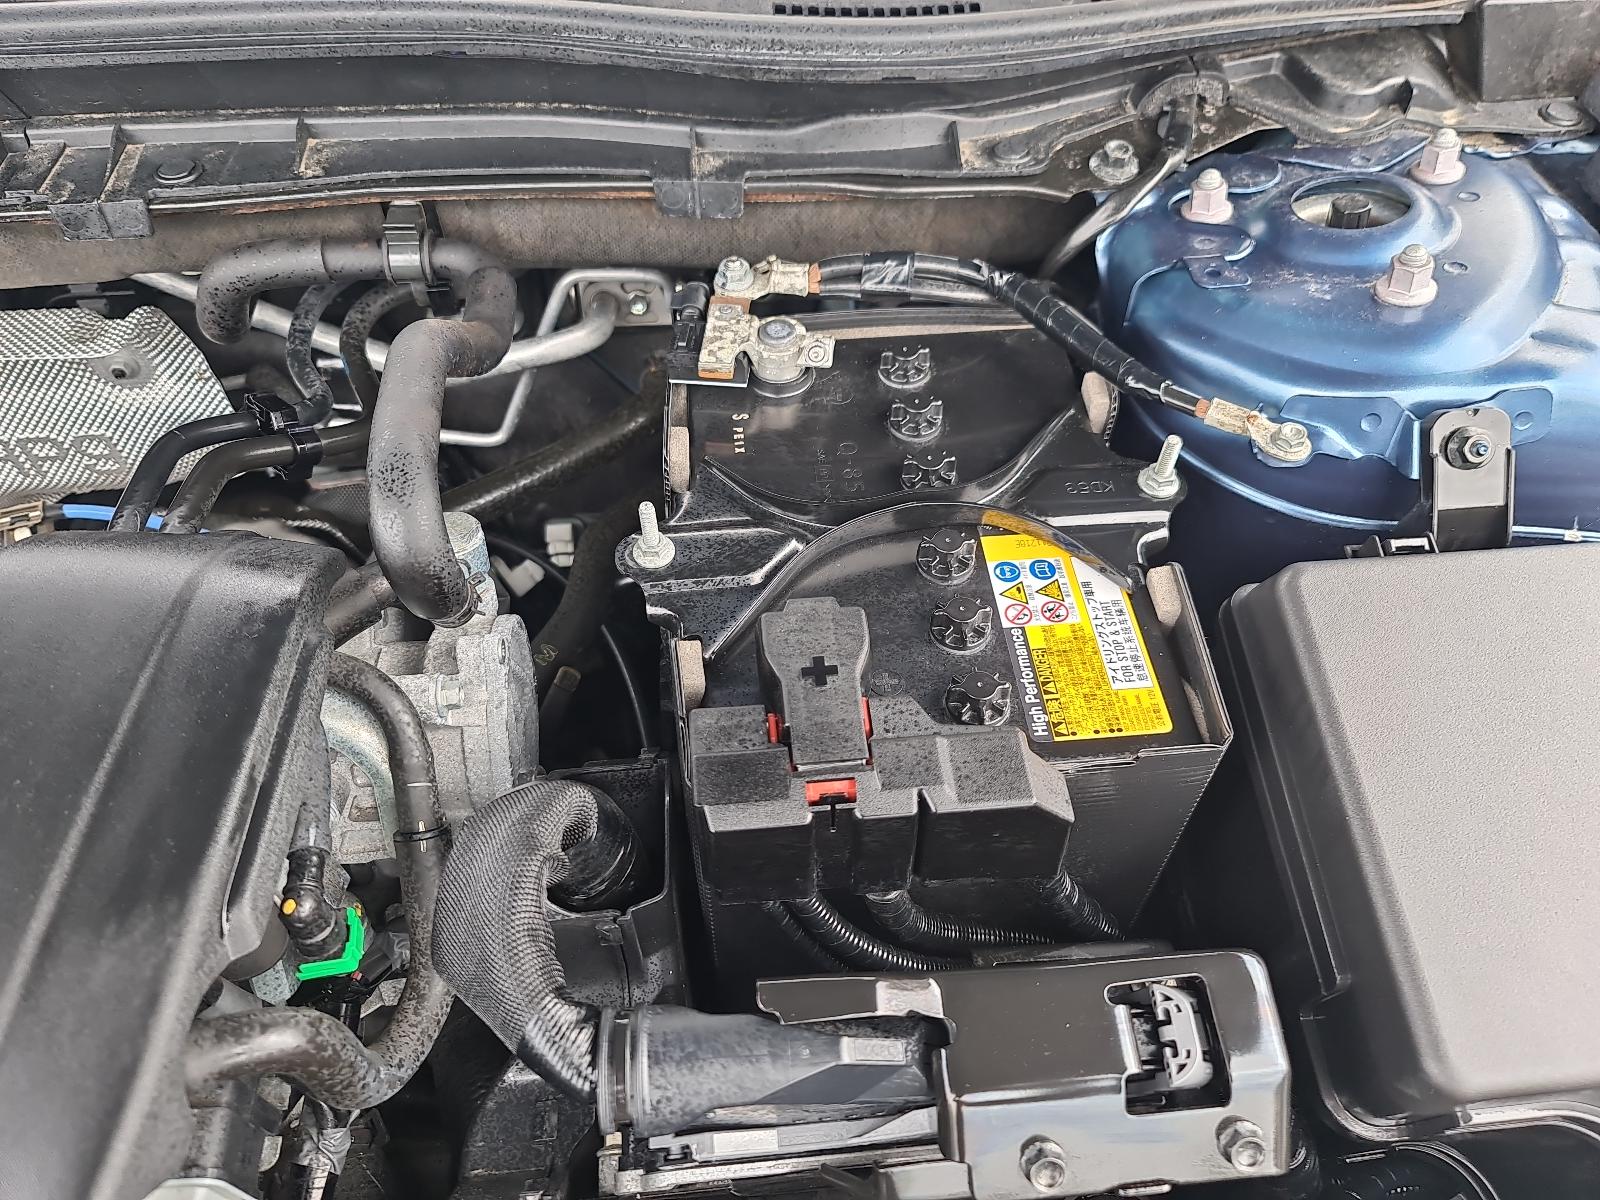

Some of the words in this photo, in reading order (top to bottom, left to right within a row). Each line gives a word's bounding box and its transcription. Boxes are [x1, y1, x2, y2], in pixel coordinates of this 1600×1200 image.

[732, 413, 750, 421] S
[1099, 601, 1116, 626] START
[1080, 581, 1123, 683] アイドリングストップ車用
[1112, 640, 1128, 661] STOP
[1011, 627, 1040, 704] Performance
[1034, 649, 1053, 681] DANGER
[1121, 664, 1135, 682] FOR
[1029, 705, 1049, 736] High
[1047, 698, 1065, 722] 危険
